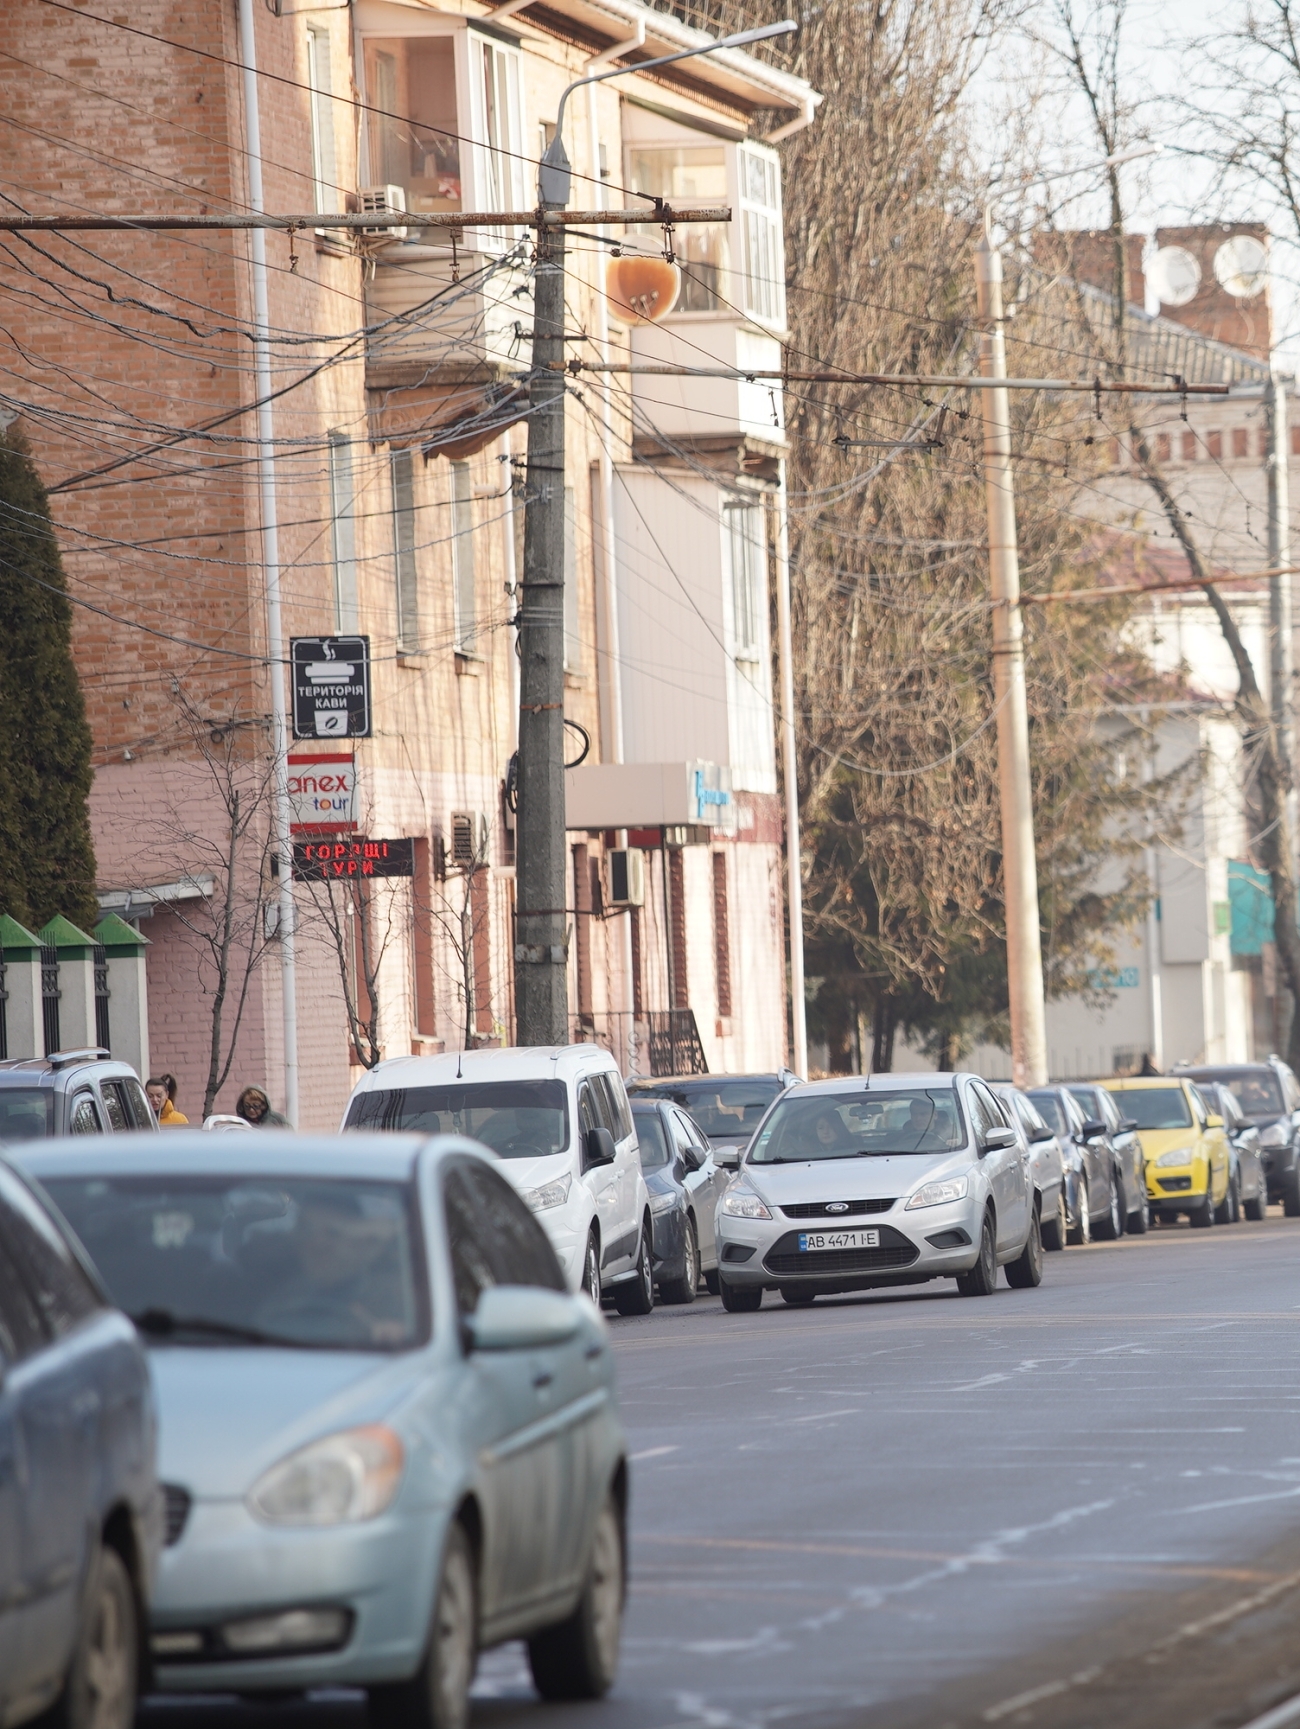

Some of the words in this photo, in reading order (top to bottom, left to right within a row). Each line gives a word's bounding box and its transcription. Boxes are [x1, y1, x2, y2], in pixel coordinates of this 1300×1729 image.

[297, 684, 364, 697] ТЕРИТОРІЯ
[315, 697, 347, 709] КАВИ
[287, 774, 349, 794] anex
[313, 796, 349, 811] tour
[808, 1235, 825, 1249] AB
[828, 1234, 856, 1247] 4471
